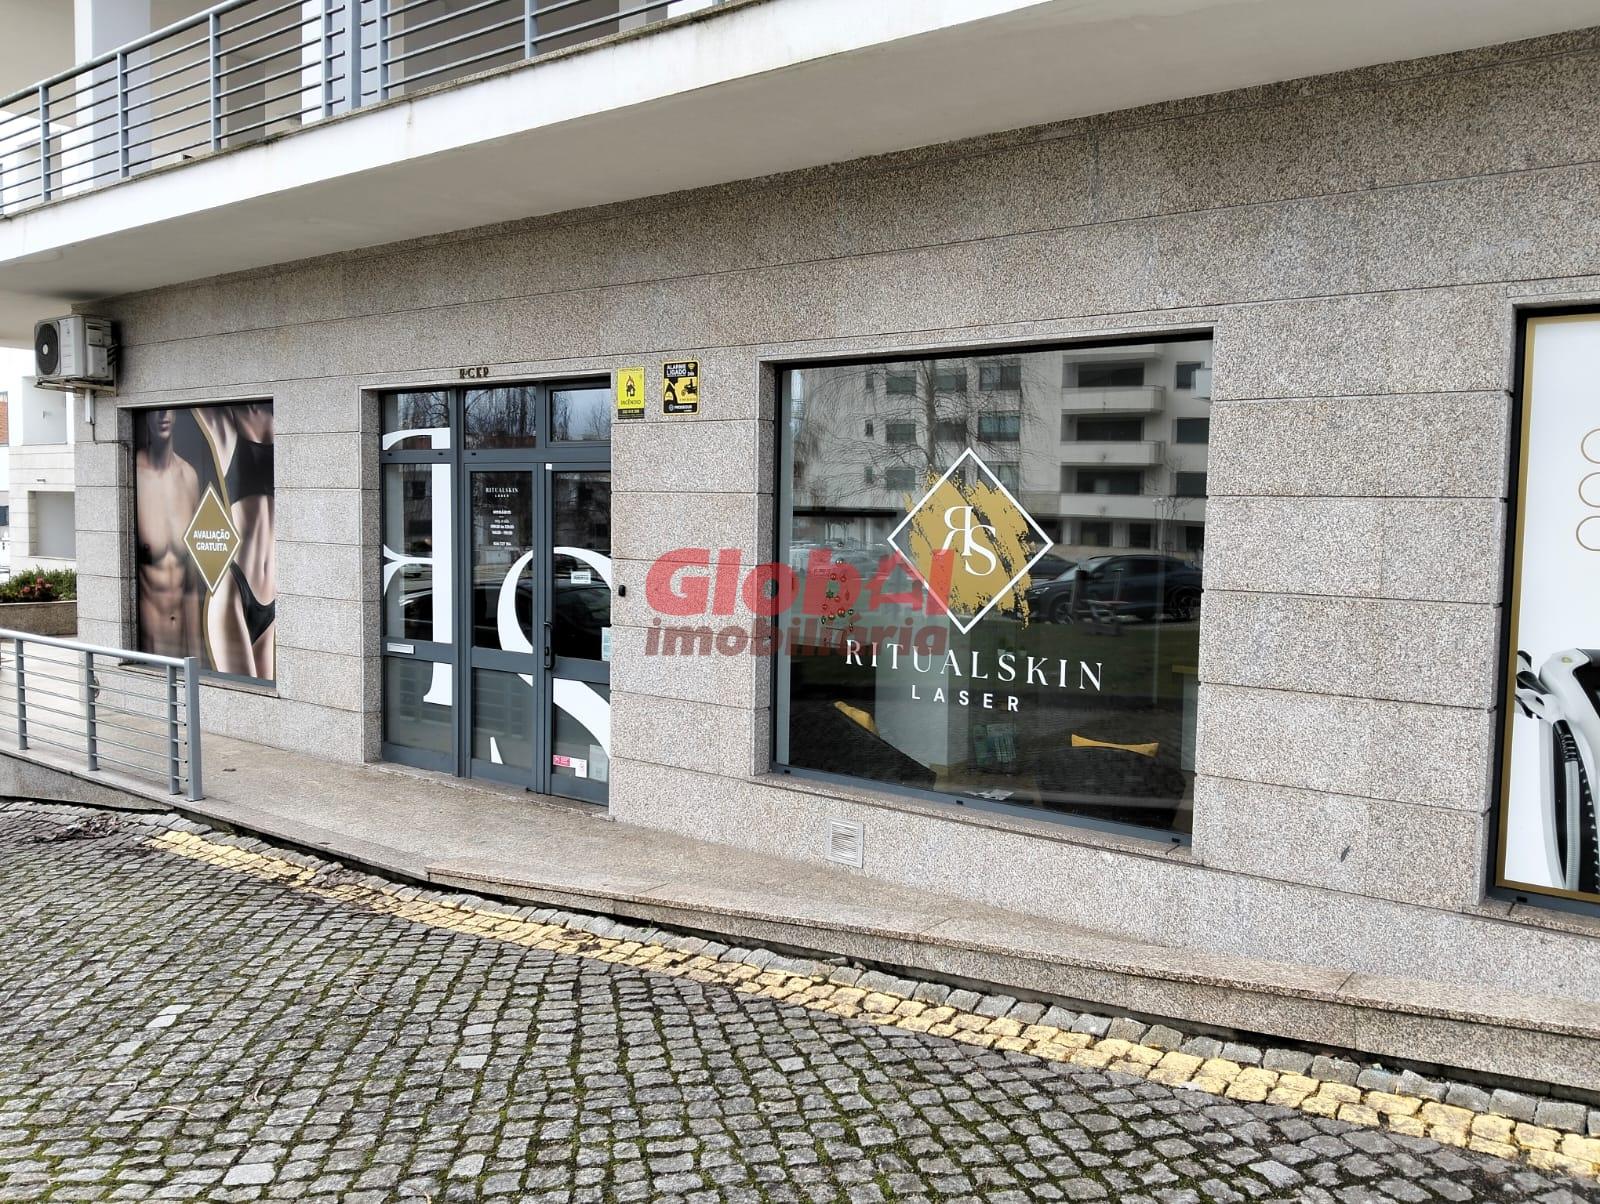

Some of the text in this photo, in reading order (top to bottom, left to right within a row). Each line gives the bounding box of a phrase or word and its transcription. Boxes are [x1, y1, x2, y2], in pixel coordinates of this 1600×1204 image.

[193, 528, 231, 542] AVALIAÇÃO
[195, 542, 228, 552] GRATUITA
[845, 638, 1103, 692] RITUALSKIN
[911, 684, 1019, 712] LASER
